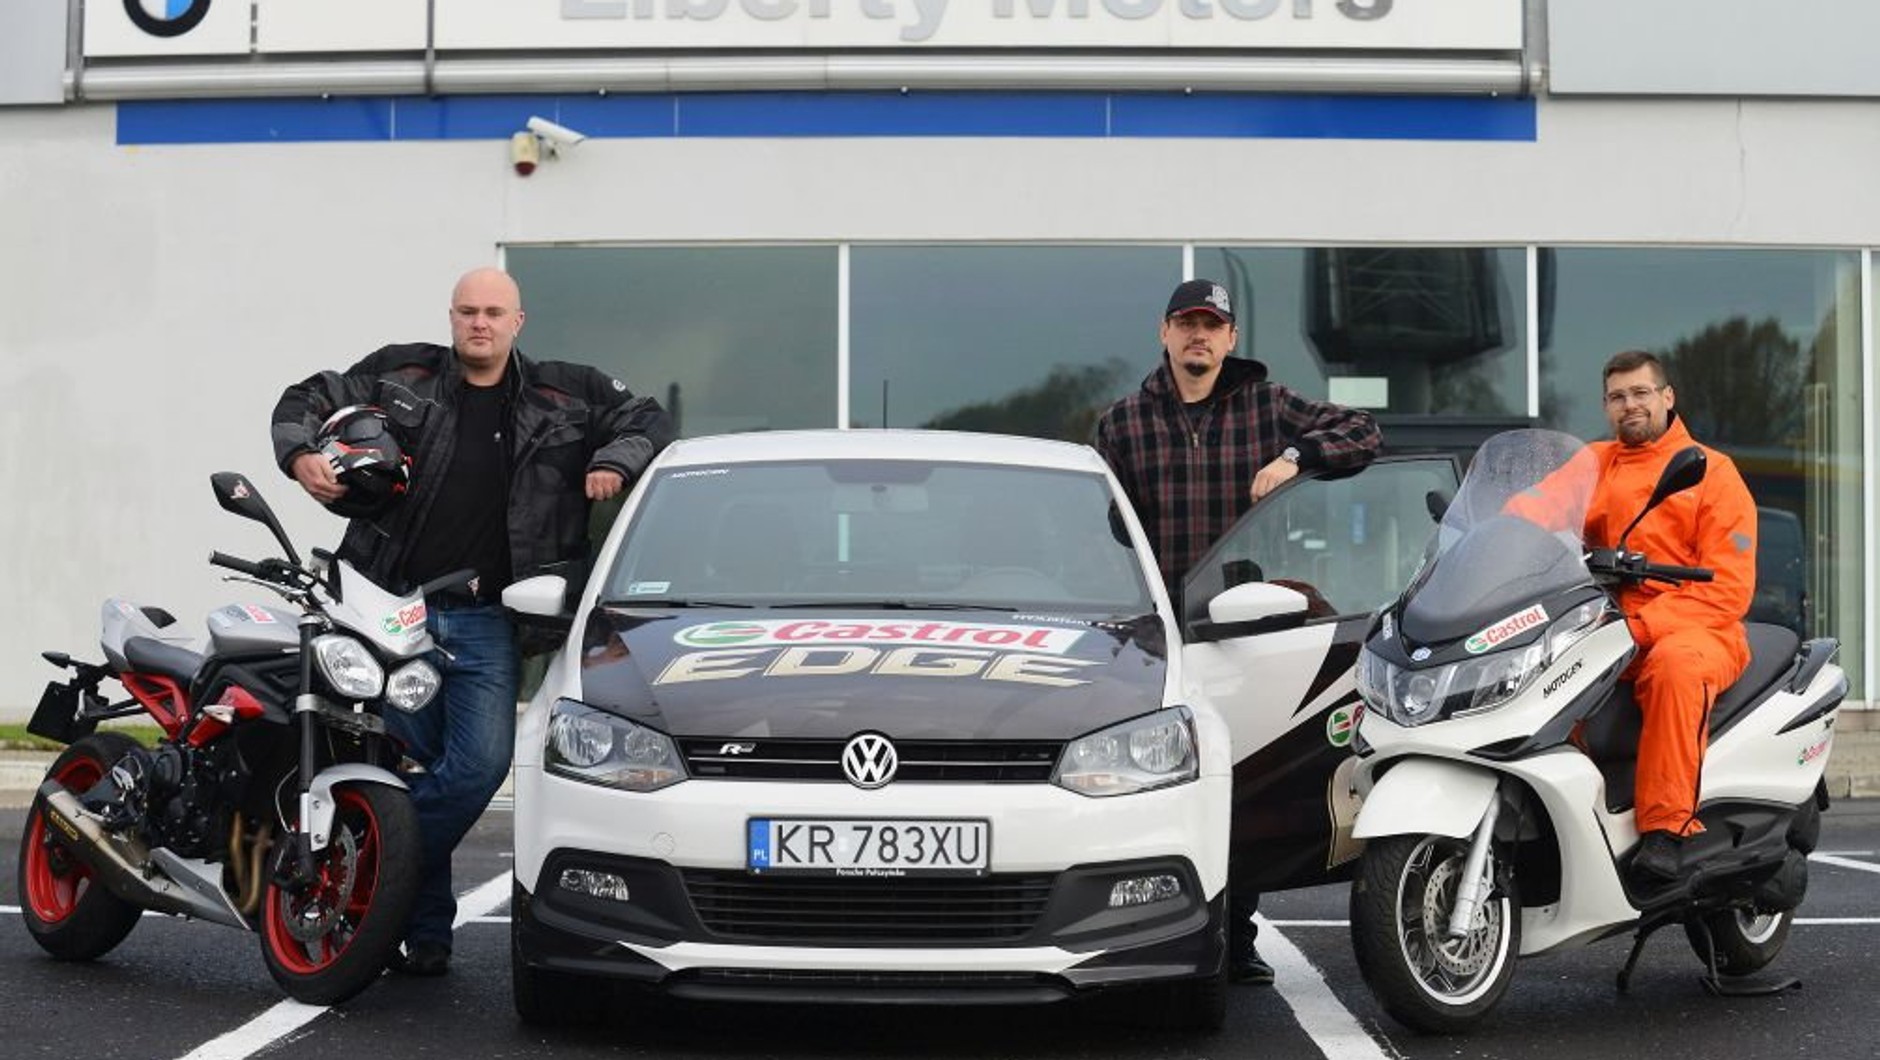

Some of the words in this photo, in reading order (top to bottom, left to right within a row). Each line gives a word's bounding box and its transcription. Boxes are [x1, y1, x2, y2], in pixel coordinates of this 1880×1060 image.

[772, 620, 1054, 648] Castrol
[1486, 608, 1545, 645] Castrol
[652, 646, 1108, 688] EDGE
[753, 849, 768, 861] PL
[777, 824, 836, 864] KR
[851, 825, 981, 865] 783XU
